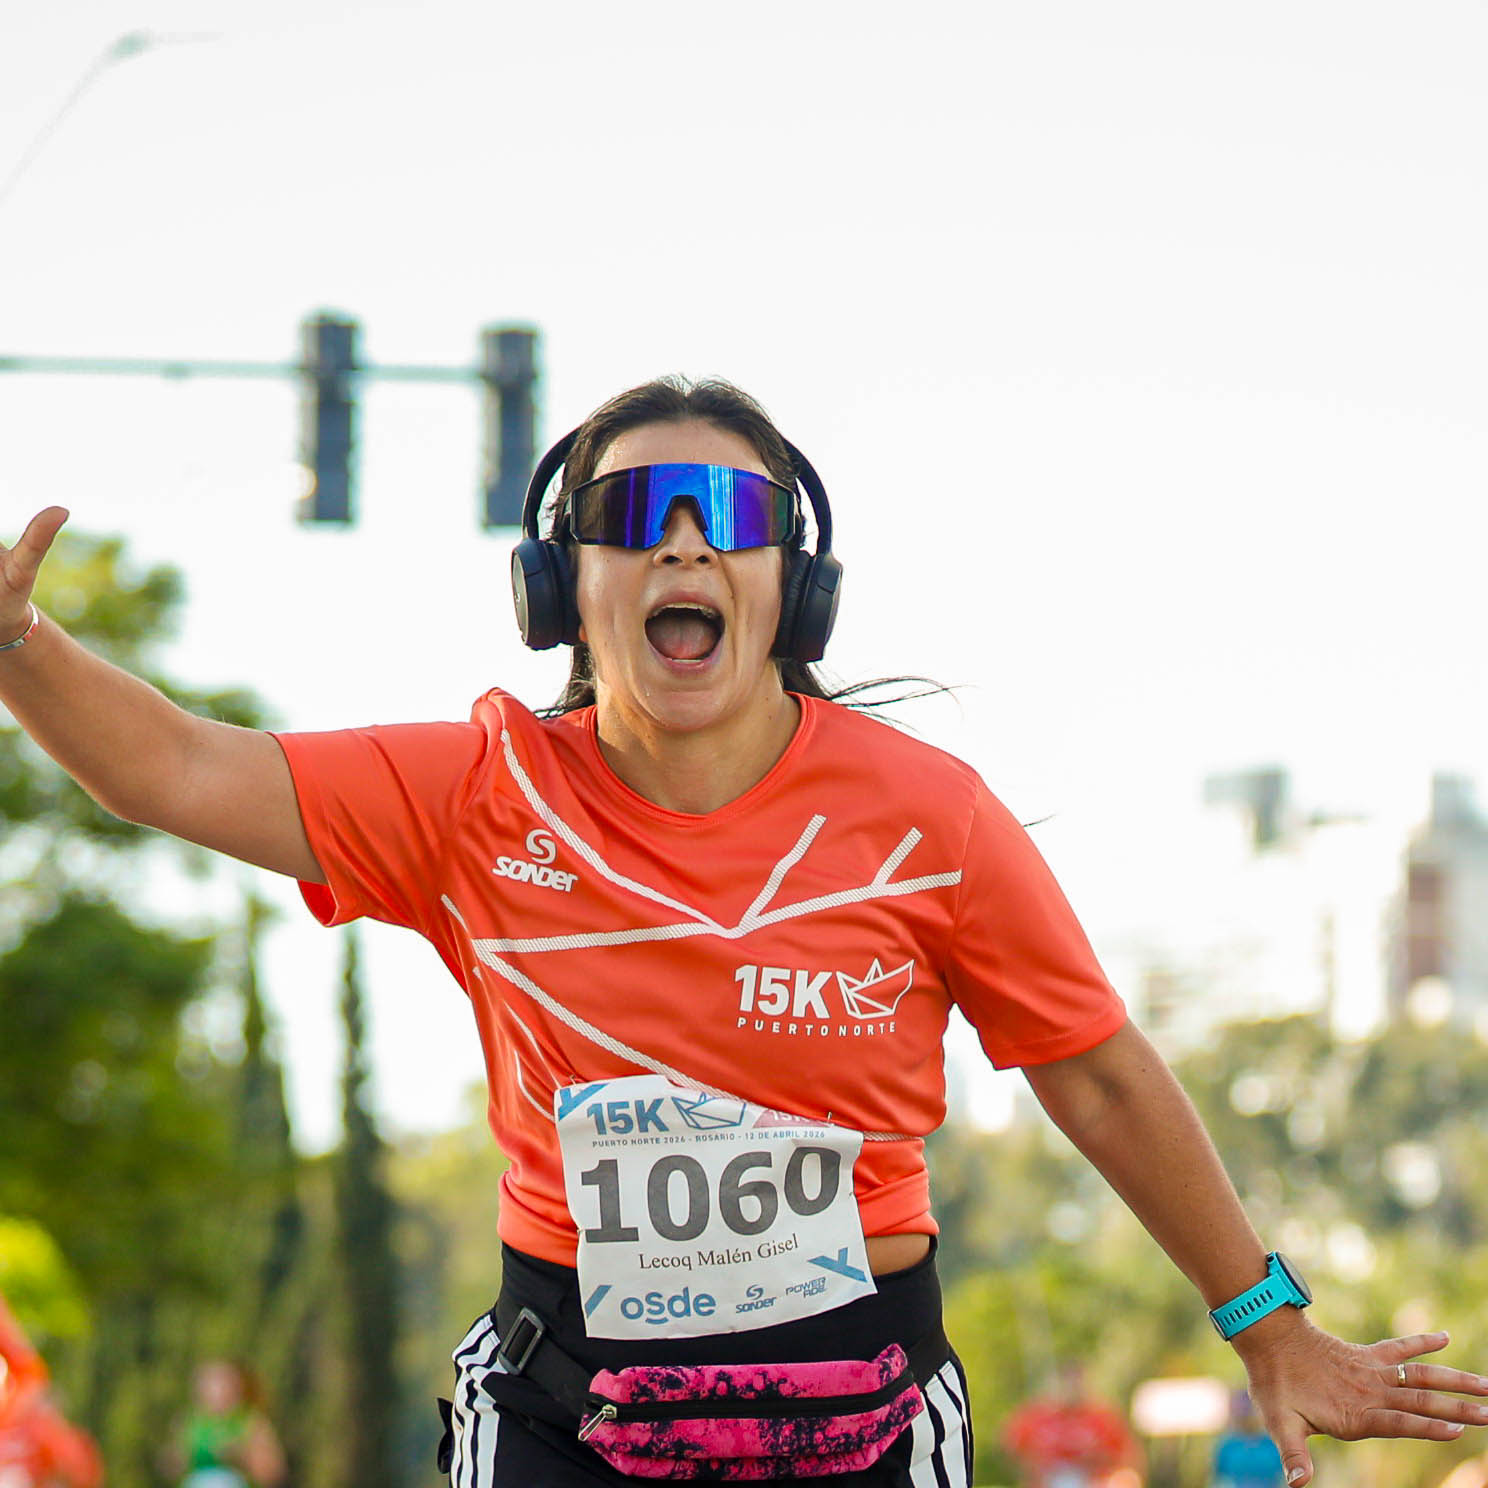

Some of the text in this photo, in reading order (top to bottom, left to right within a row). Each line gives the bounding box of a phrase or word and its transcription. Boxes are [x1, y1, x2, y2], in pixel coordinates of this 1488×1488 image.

[734, 964, 833, 1019] 15K
[737, 1016, 896, 1037] PUERTO NORTE
[586, 1097, 670, 1136] 15K
[592, 1139, 628, 1148] PUERTO
[630, 1137, 661, 1146] NORTE
[695, 1132, 735, 1143] ROSARIO
[758, 1131, 769, 1140] DE
[772, 1130, 800, 1139] ABRIL
[581, 1146, 842, 1243] 1060
[639, 1233, 799, 1271] Lecoq Malén Gisel
[620, 1286, 717, 1324] osde
